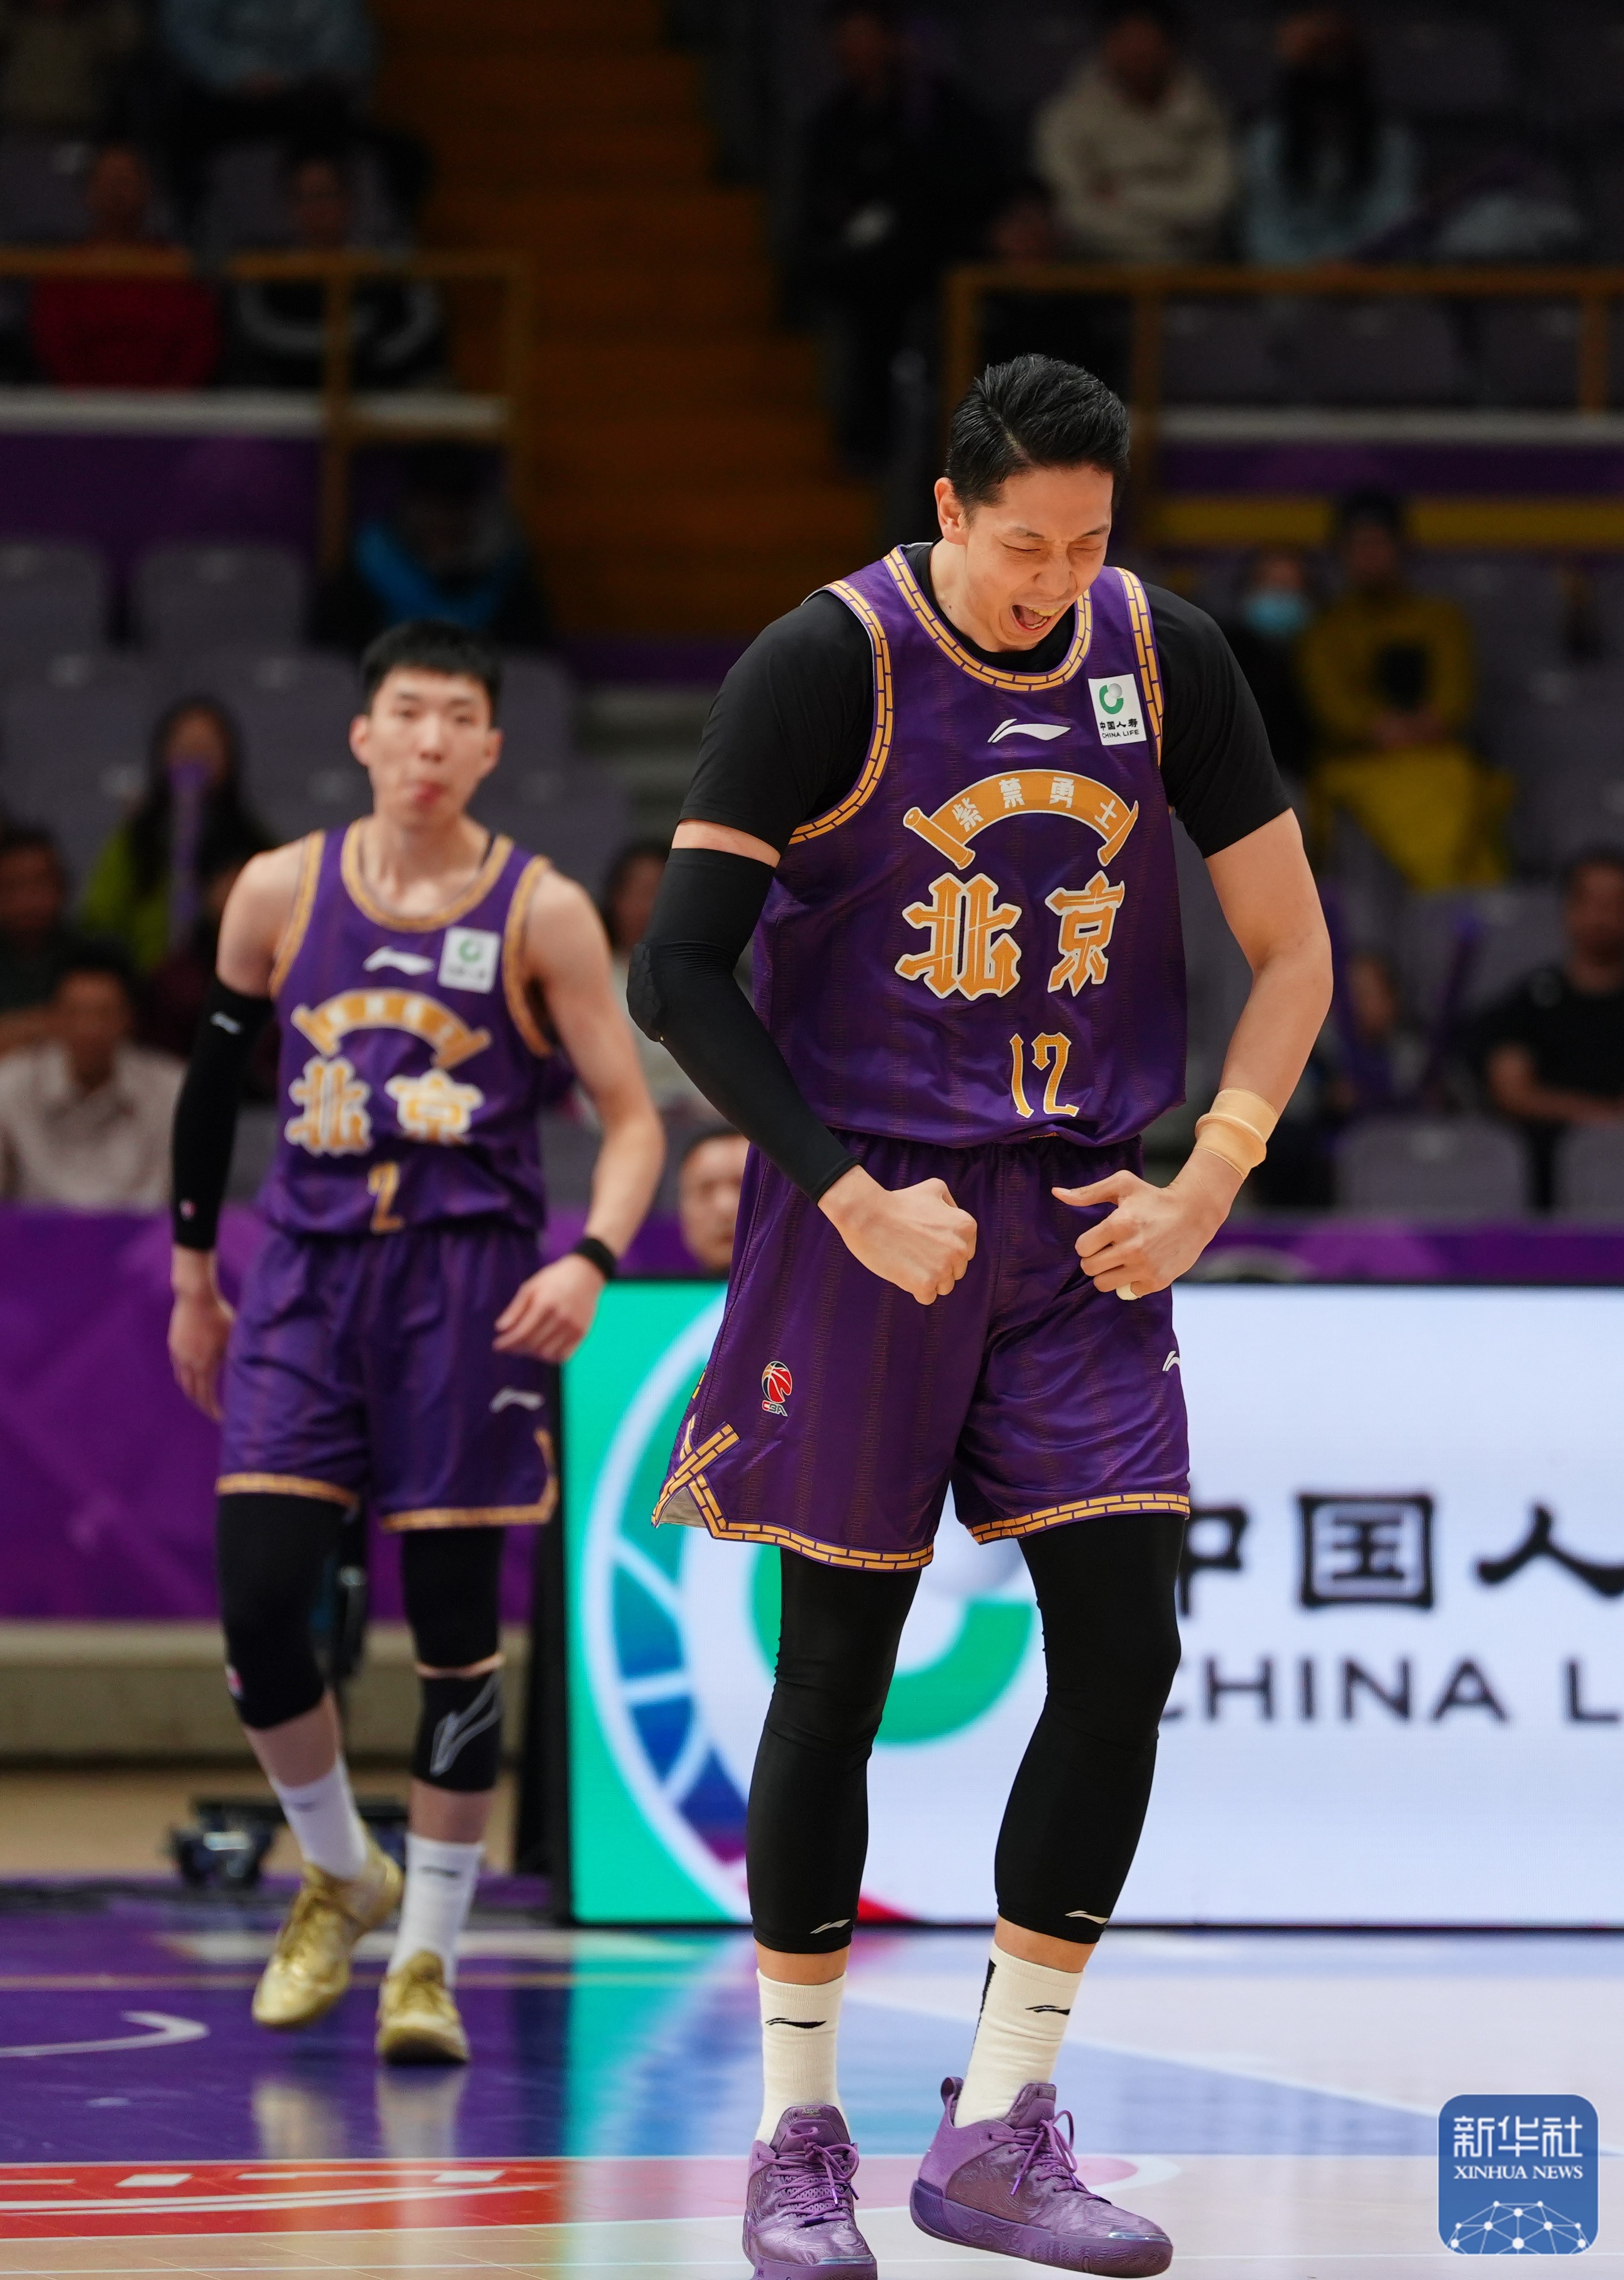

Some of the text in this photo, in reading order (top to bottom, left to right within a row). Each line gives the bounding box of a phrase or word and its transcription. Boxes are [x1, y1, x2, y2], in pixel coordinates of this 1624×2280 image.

[1099, 718, 1137, 731] 中国人寿
[895, 870, 1125, 1001] 北京
[1009, 1032, 1080, 1118] 12
[368, 1160, 405, 1234] 2
[762, 1400, 788, 1417] CBA
[1160, 1656, 1508, 1724] HINA
